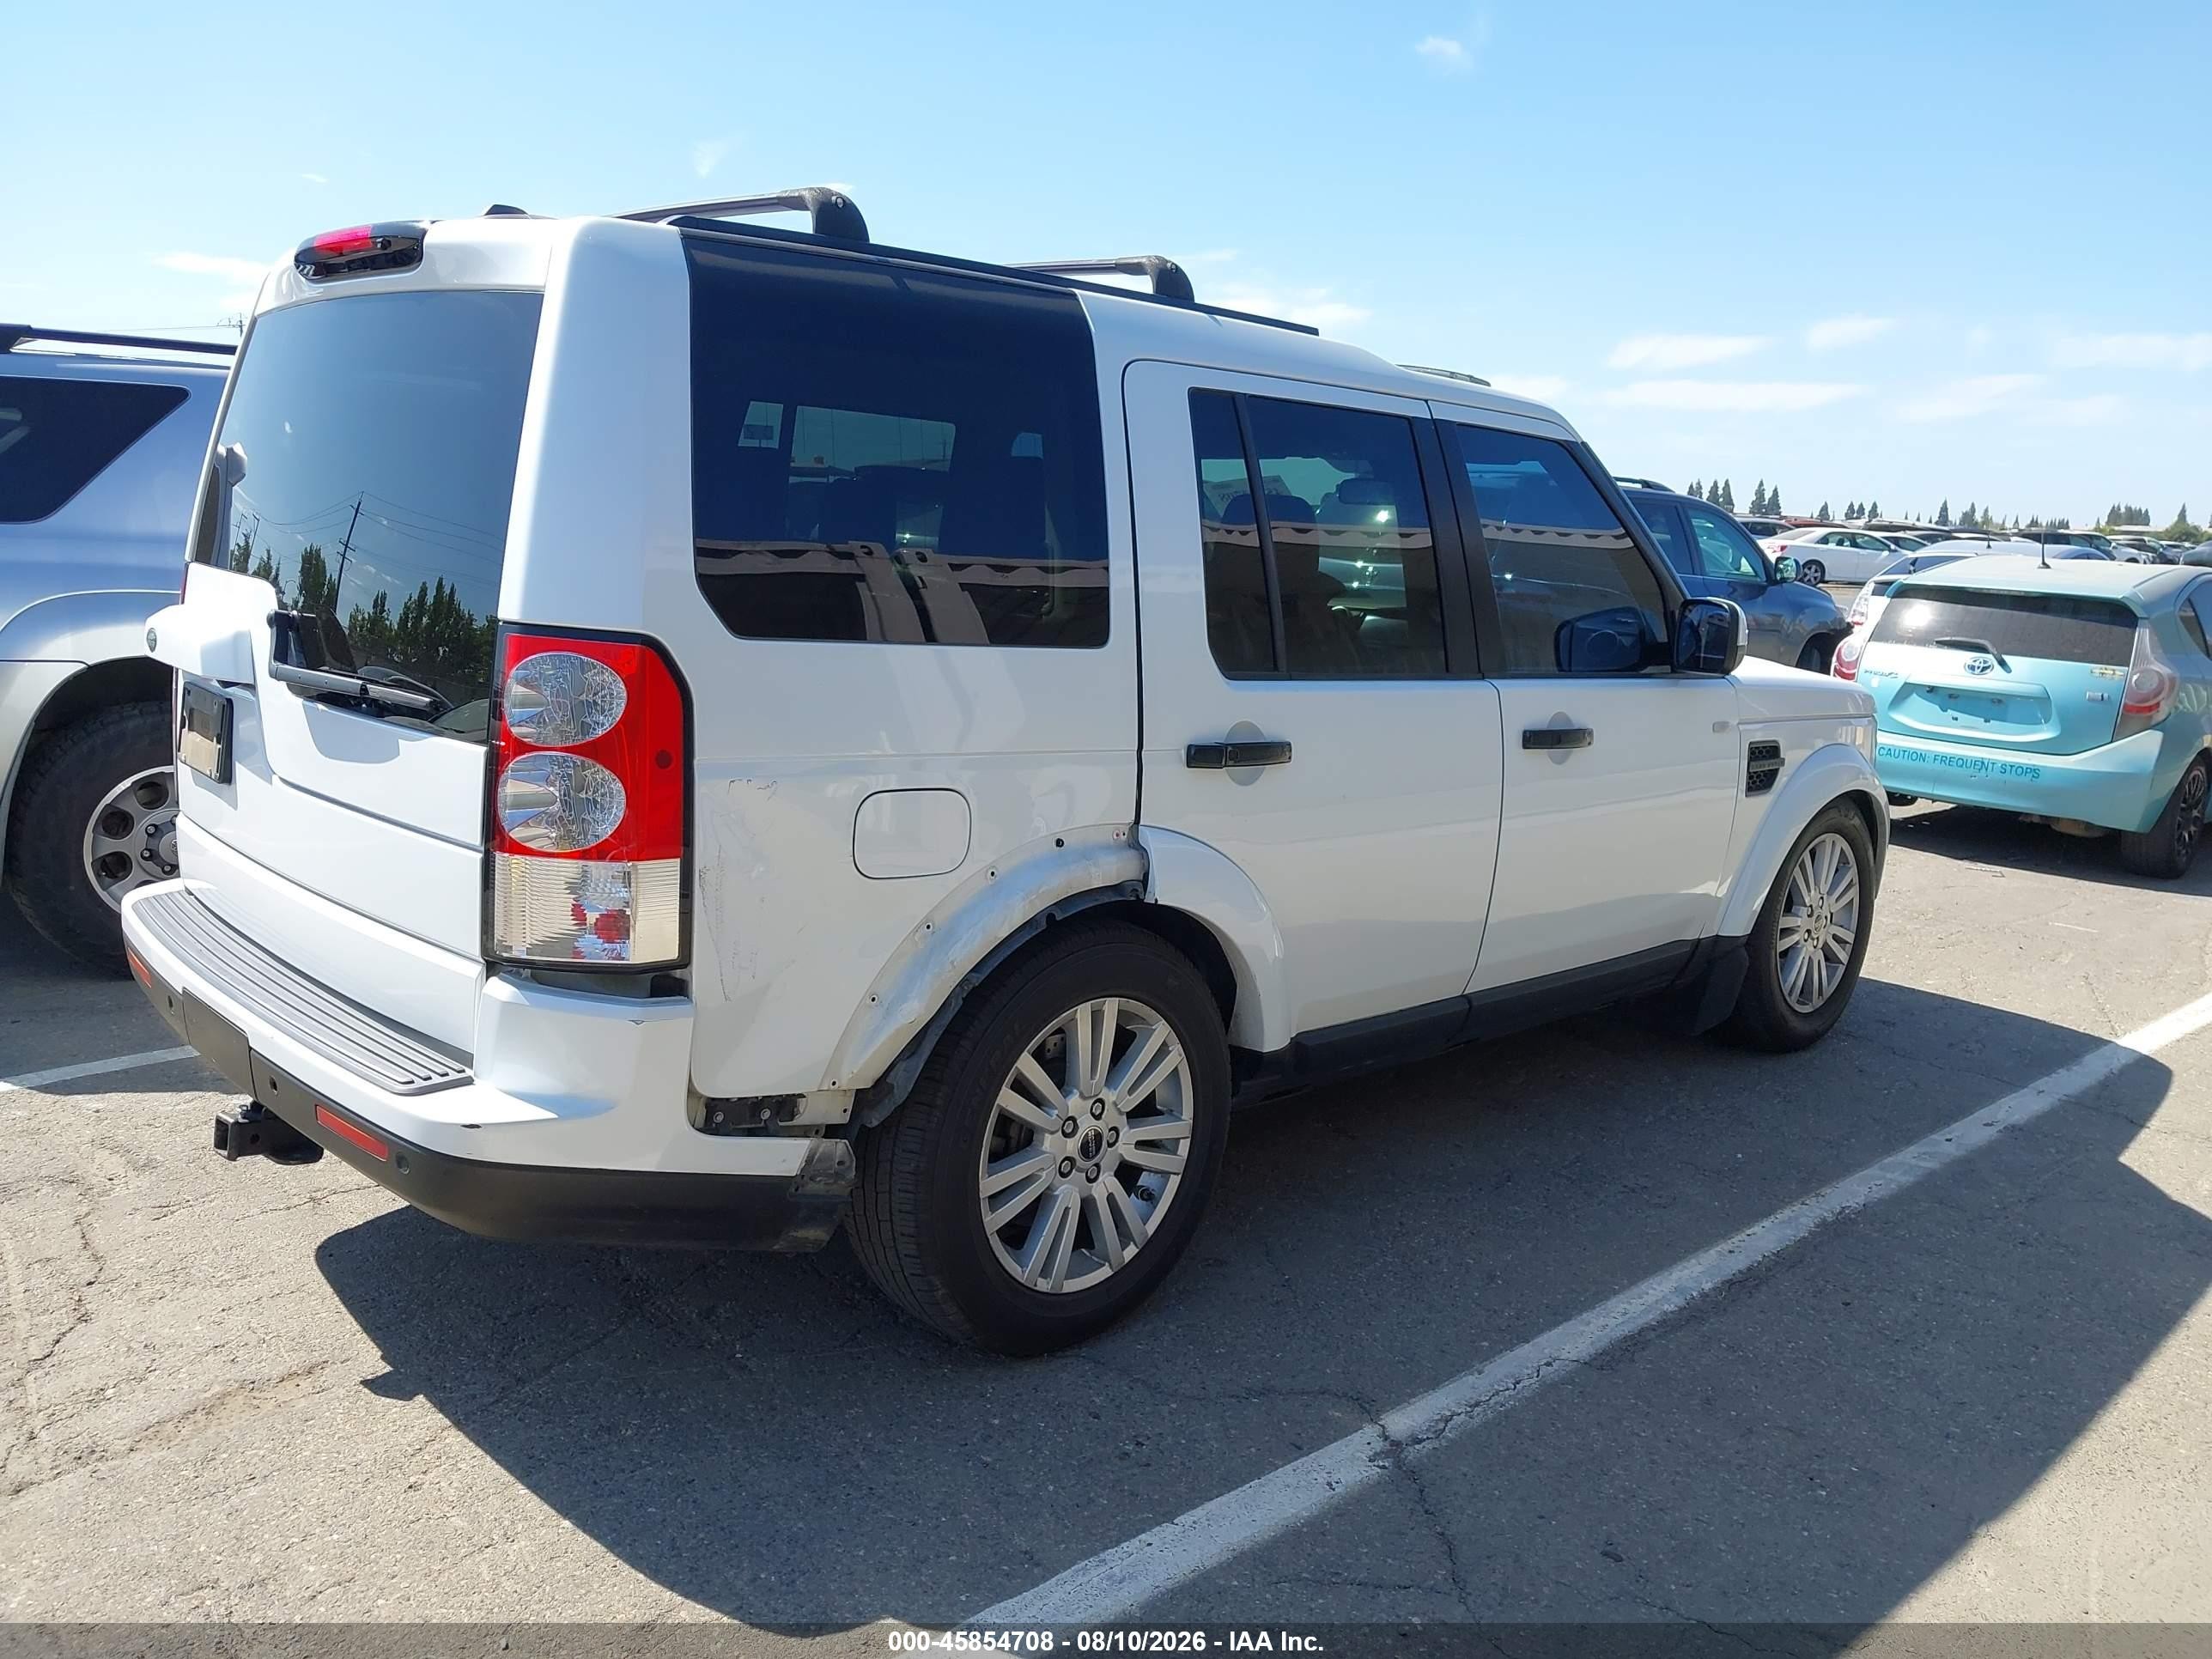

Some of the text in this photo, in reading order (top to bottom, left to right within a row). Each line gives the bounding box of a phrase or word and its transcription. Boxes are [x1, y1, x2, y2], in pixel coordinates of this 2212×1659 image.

[1878, 746, 2041, 780] CAUTION: FREQUENT STOPS
